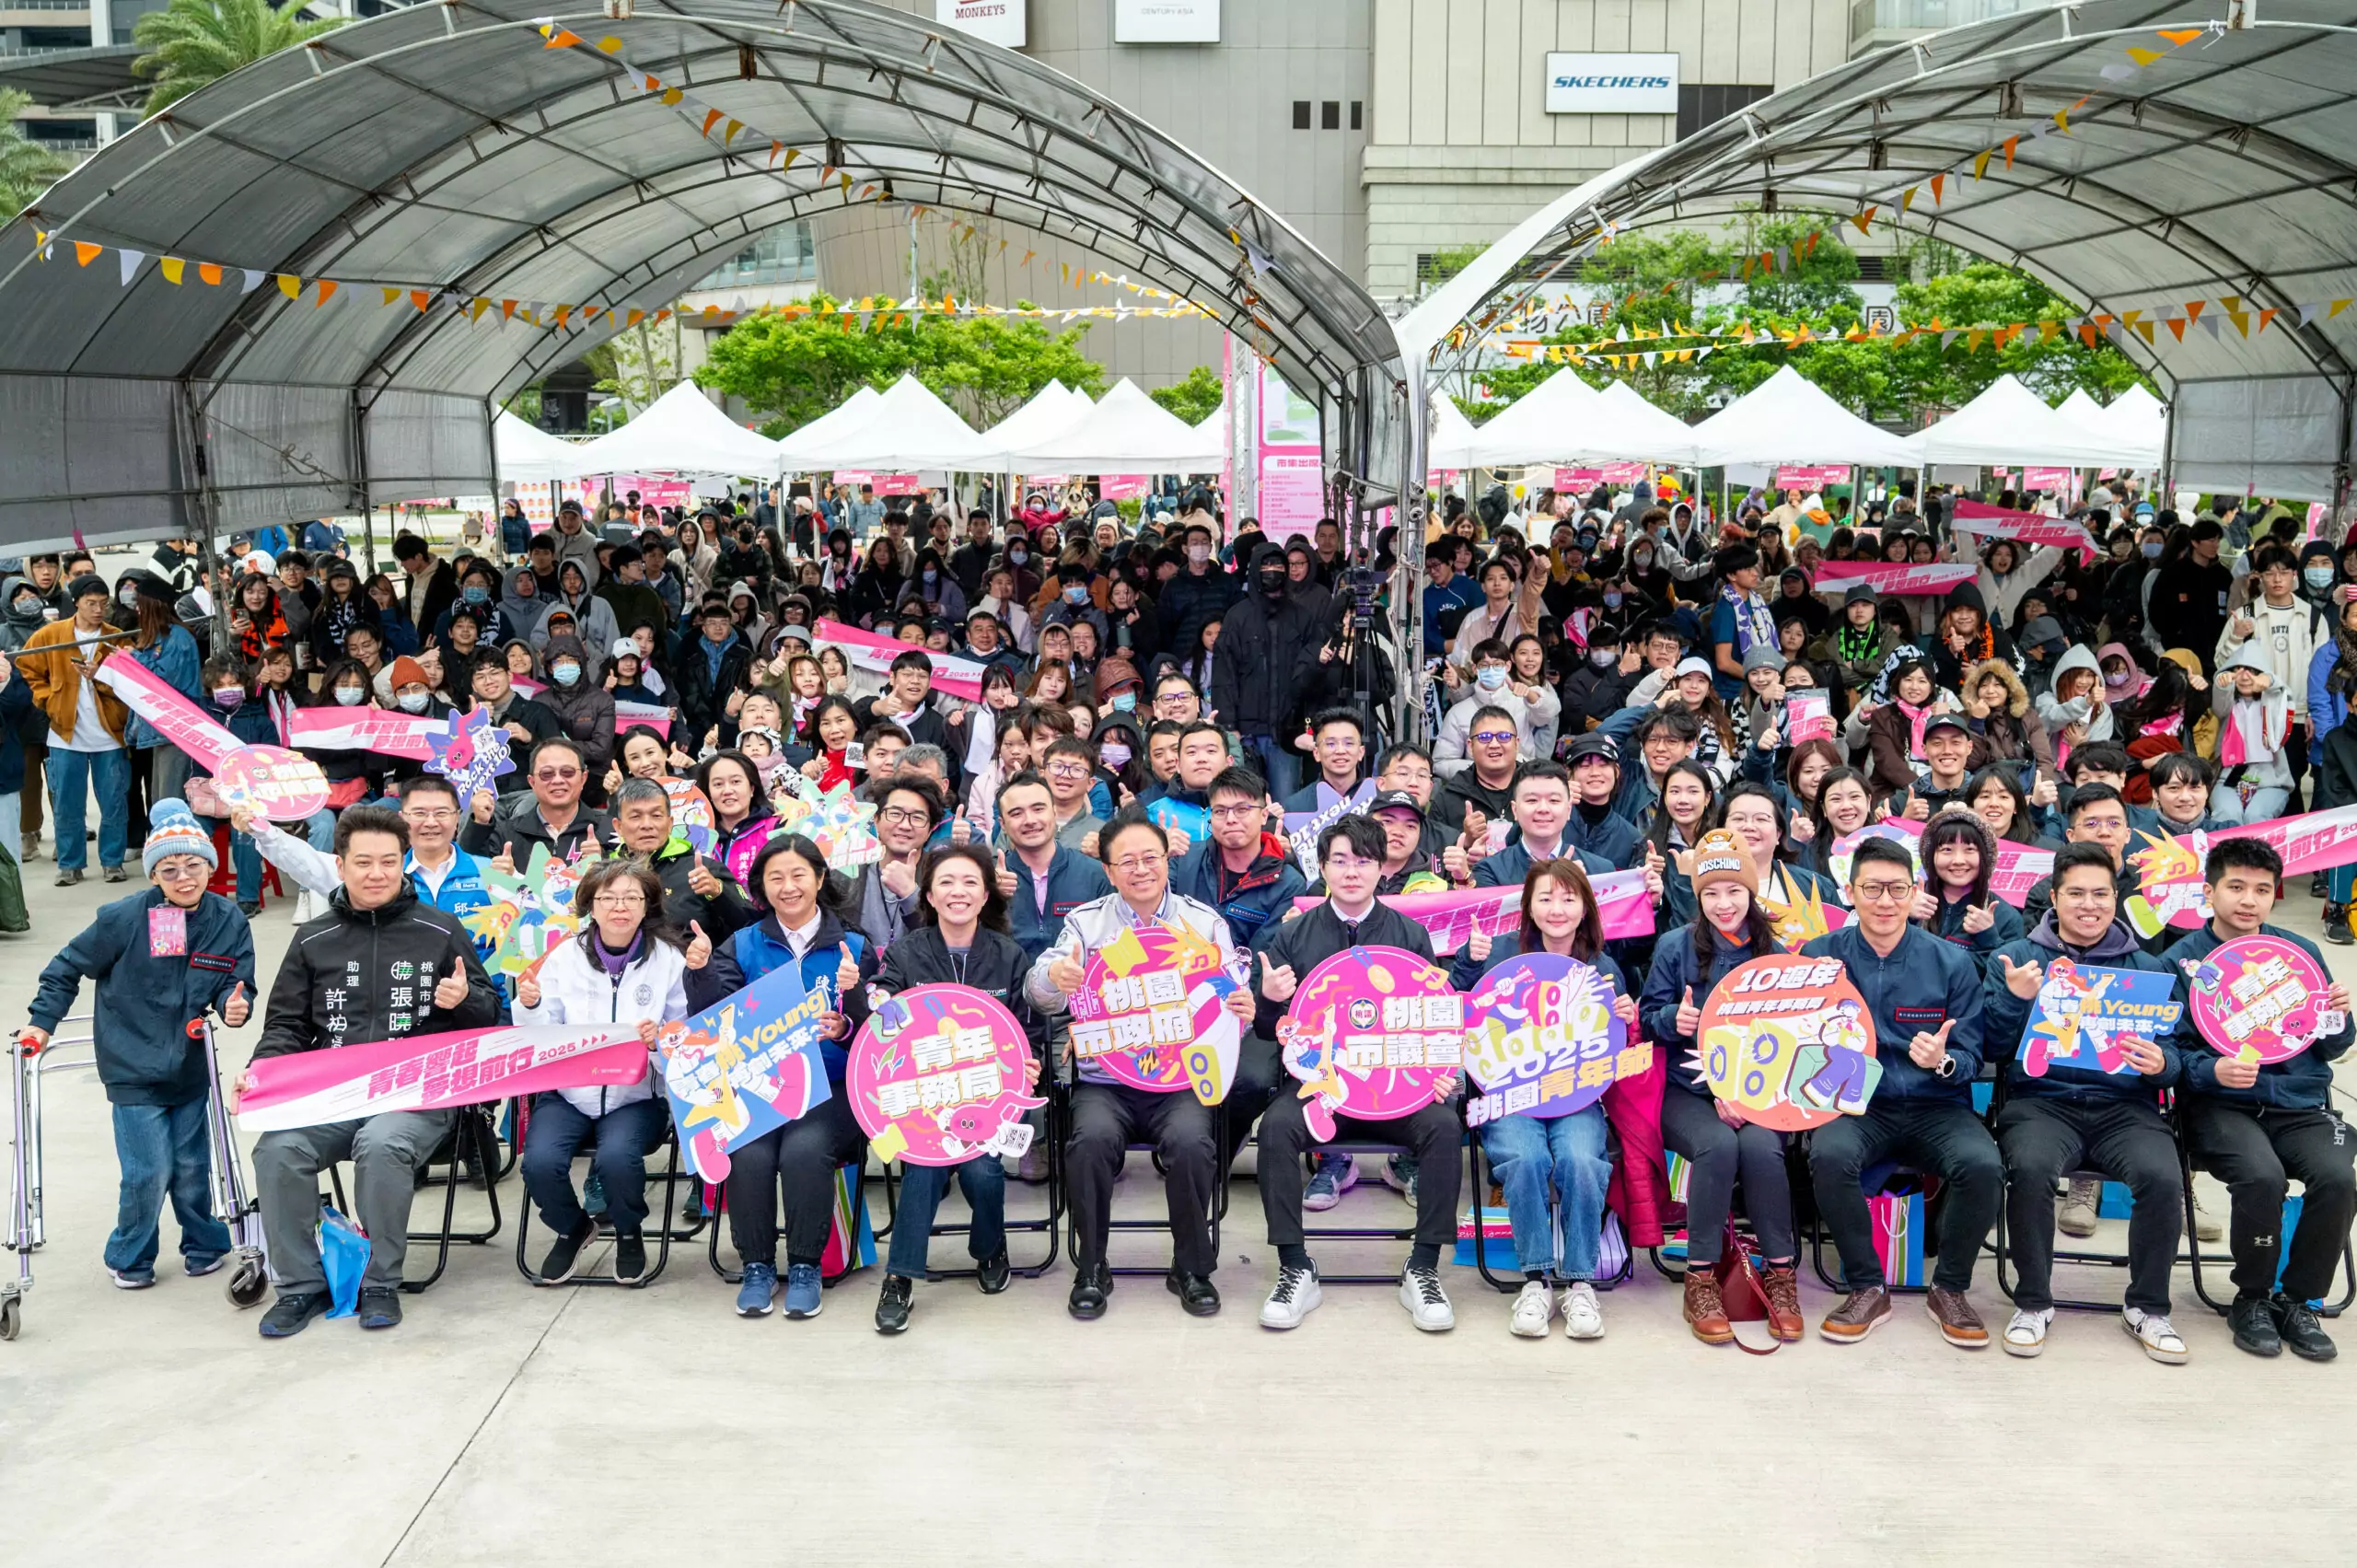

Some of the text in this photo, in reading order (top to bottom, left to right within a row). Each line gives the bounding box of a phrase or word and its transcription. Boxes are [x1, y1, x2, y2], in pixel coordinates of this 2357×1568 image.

[956, 5, 1005, 18] MONKEYS
[1553, 75, 1671, 88] SKECHERS
[458, 742, 500, 798] Rock the
[472, 745, 508, 794] next 10
[1311, 796, 1351, 832] next
[1697, 858, 1741, 873] MOSCHINO
[346, 960, 360, 987] 助理
[418, 960, 435, 1027] 桃園市議
[1102, 970, 1187, 1014] 桃園
[1732, 963, 1843, 993] 10週年
[2228, 955, 2292, 1005] 青年
[389, 987, 413, 1041] 張曉
[1069, 1006, 1194, 1058] 市政府
[1383, 995, 1463, 1030] 桃園
[2221, 976, 2309, 1041] 事務局
[367, 1039, 480, 1100] 青春響起
[421, 1042, 576, 1105] 夢想前行 2025
[911, 1025, 996, 1073] 青年
[1346, 1033, 1465, 1067] 市議會
[1484, 1028, 1609, 1091] 2025
[877, 1062, 1002, 1118] 事務局
[1466, 1040, 1654, 1128] 桃園青年節
